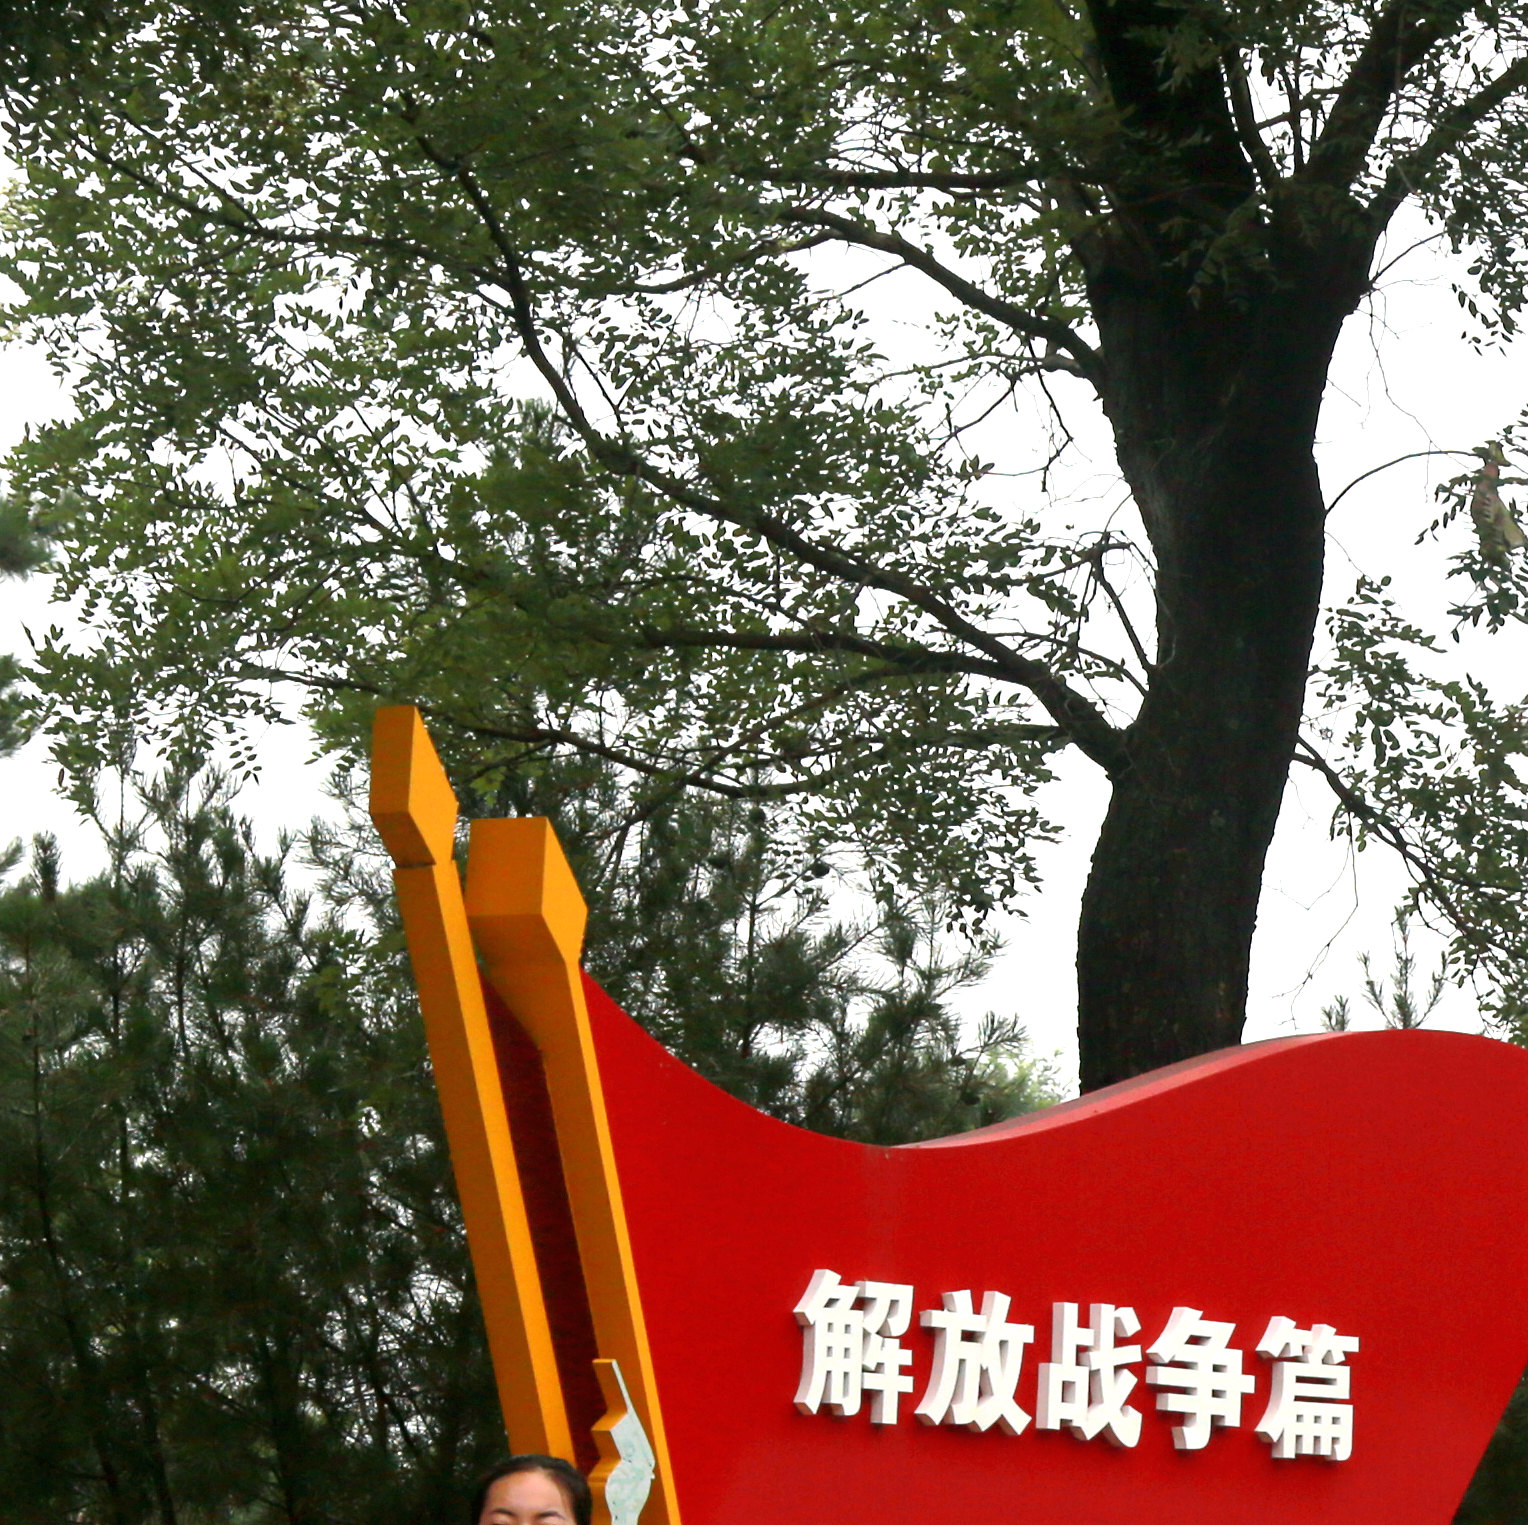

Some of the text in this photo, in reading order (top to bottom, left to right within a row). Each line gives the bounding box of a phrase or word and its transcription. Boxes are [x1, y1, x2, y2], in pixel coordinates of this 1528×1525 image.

[792, 1268, 1361, 1463] 解放战争篇
